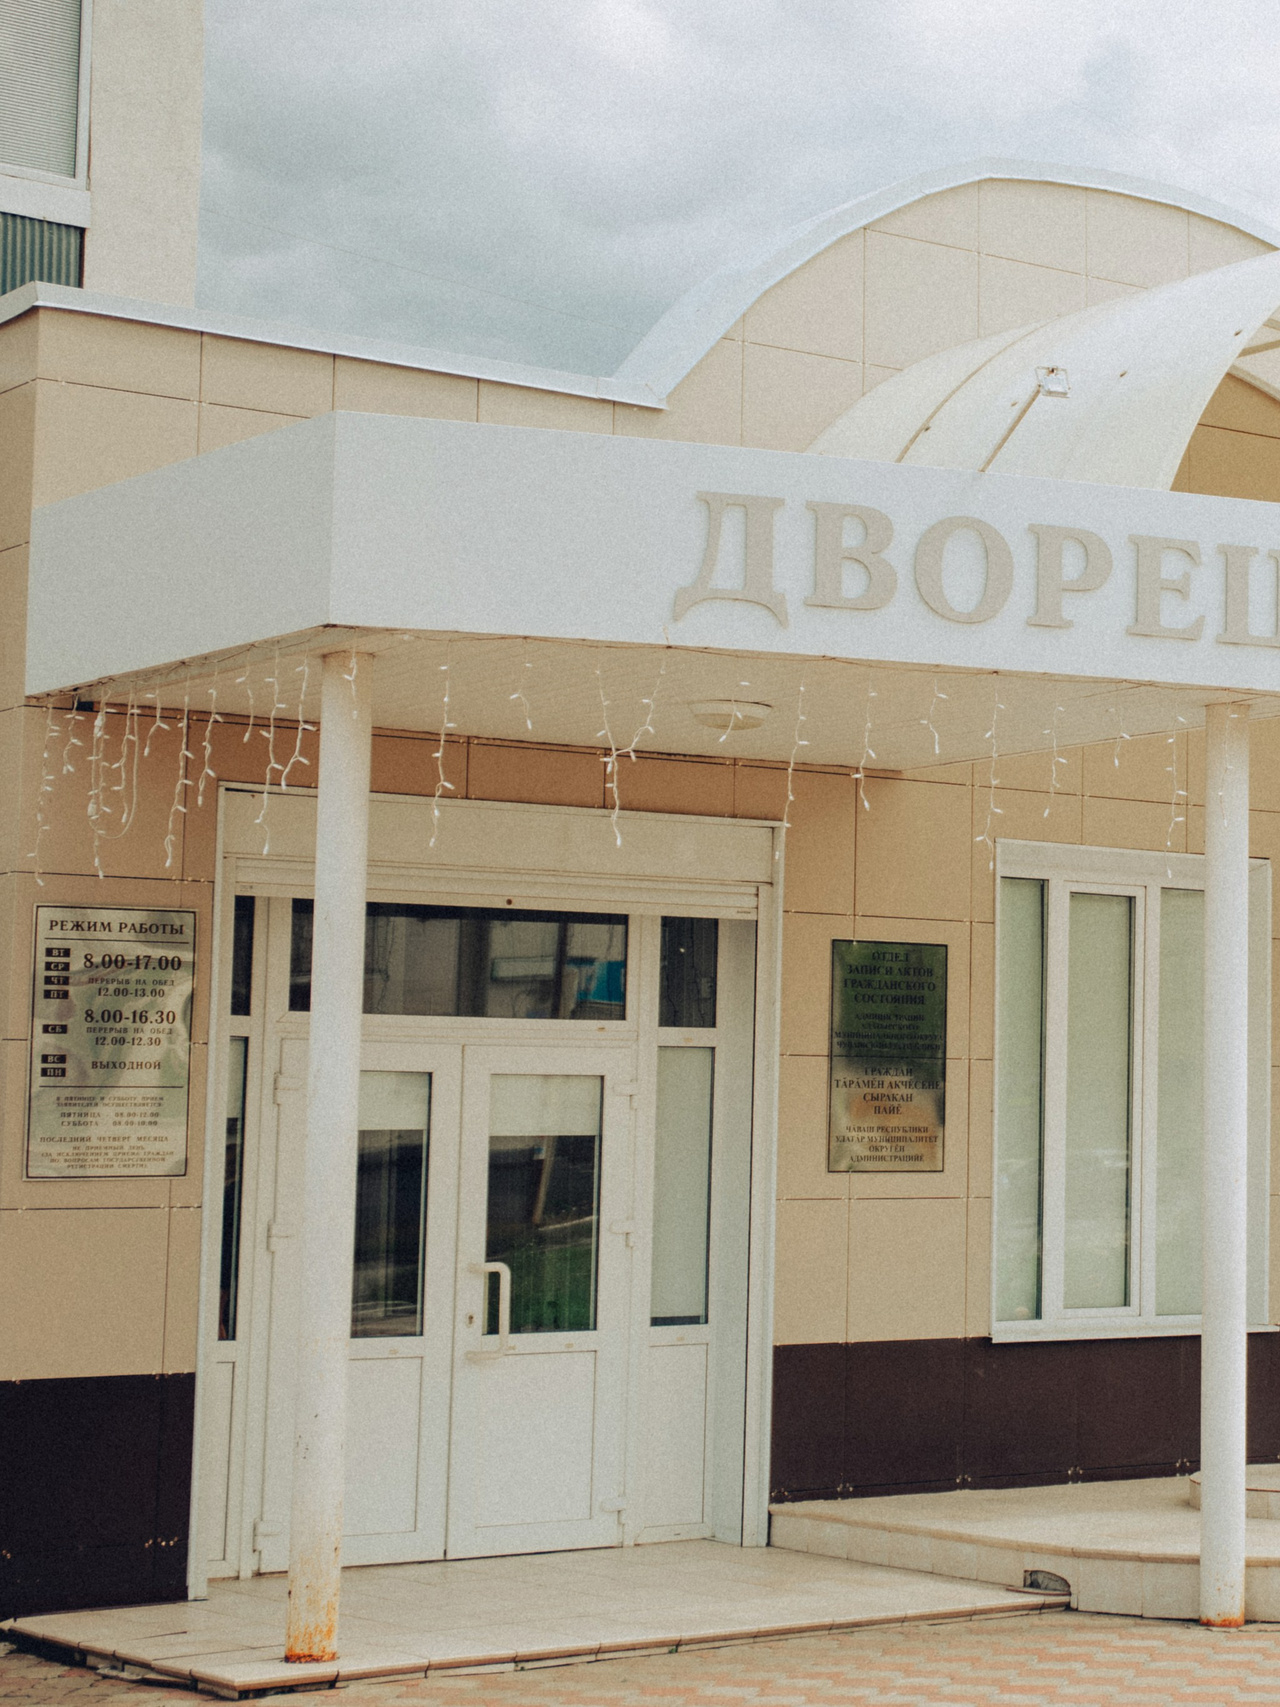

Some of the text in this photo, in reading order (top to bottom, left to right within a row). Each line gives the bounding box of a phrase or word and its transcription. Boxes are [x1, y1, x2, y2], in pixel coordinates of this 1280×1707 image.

[49, 920, 184, 935] РЕЖИМ РАБОТЫ
[83, 953, 182, 971] 8.00-17.00
[897, 966, 934, 978] АКТОВ
[152, 979, 175, 987] ОБЕД
[844, 979, 936, 992] ГРАЖДАНСКОГО
[98, 987, 165, 998] 12.00-13.00
[854, 993, 925, 1005] СОСТОЯНИЯ
[84, 1009, 176, 1025] 8.00-16.30
[95, 1036, 161, 1046] 12.00-12.30
[91, 1060, 161, 1070] ВЫХОДНОЙ
[864, 1067, 913, 1077] ГРАЖДАН
